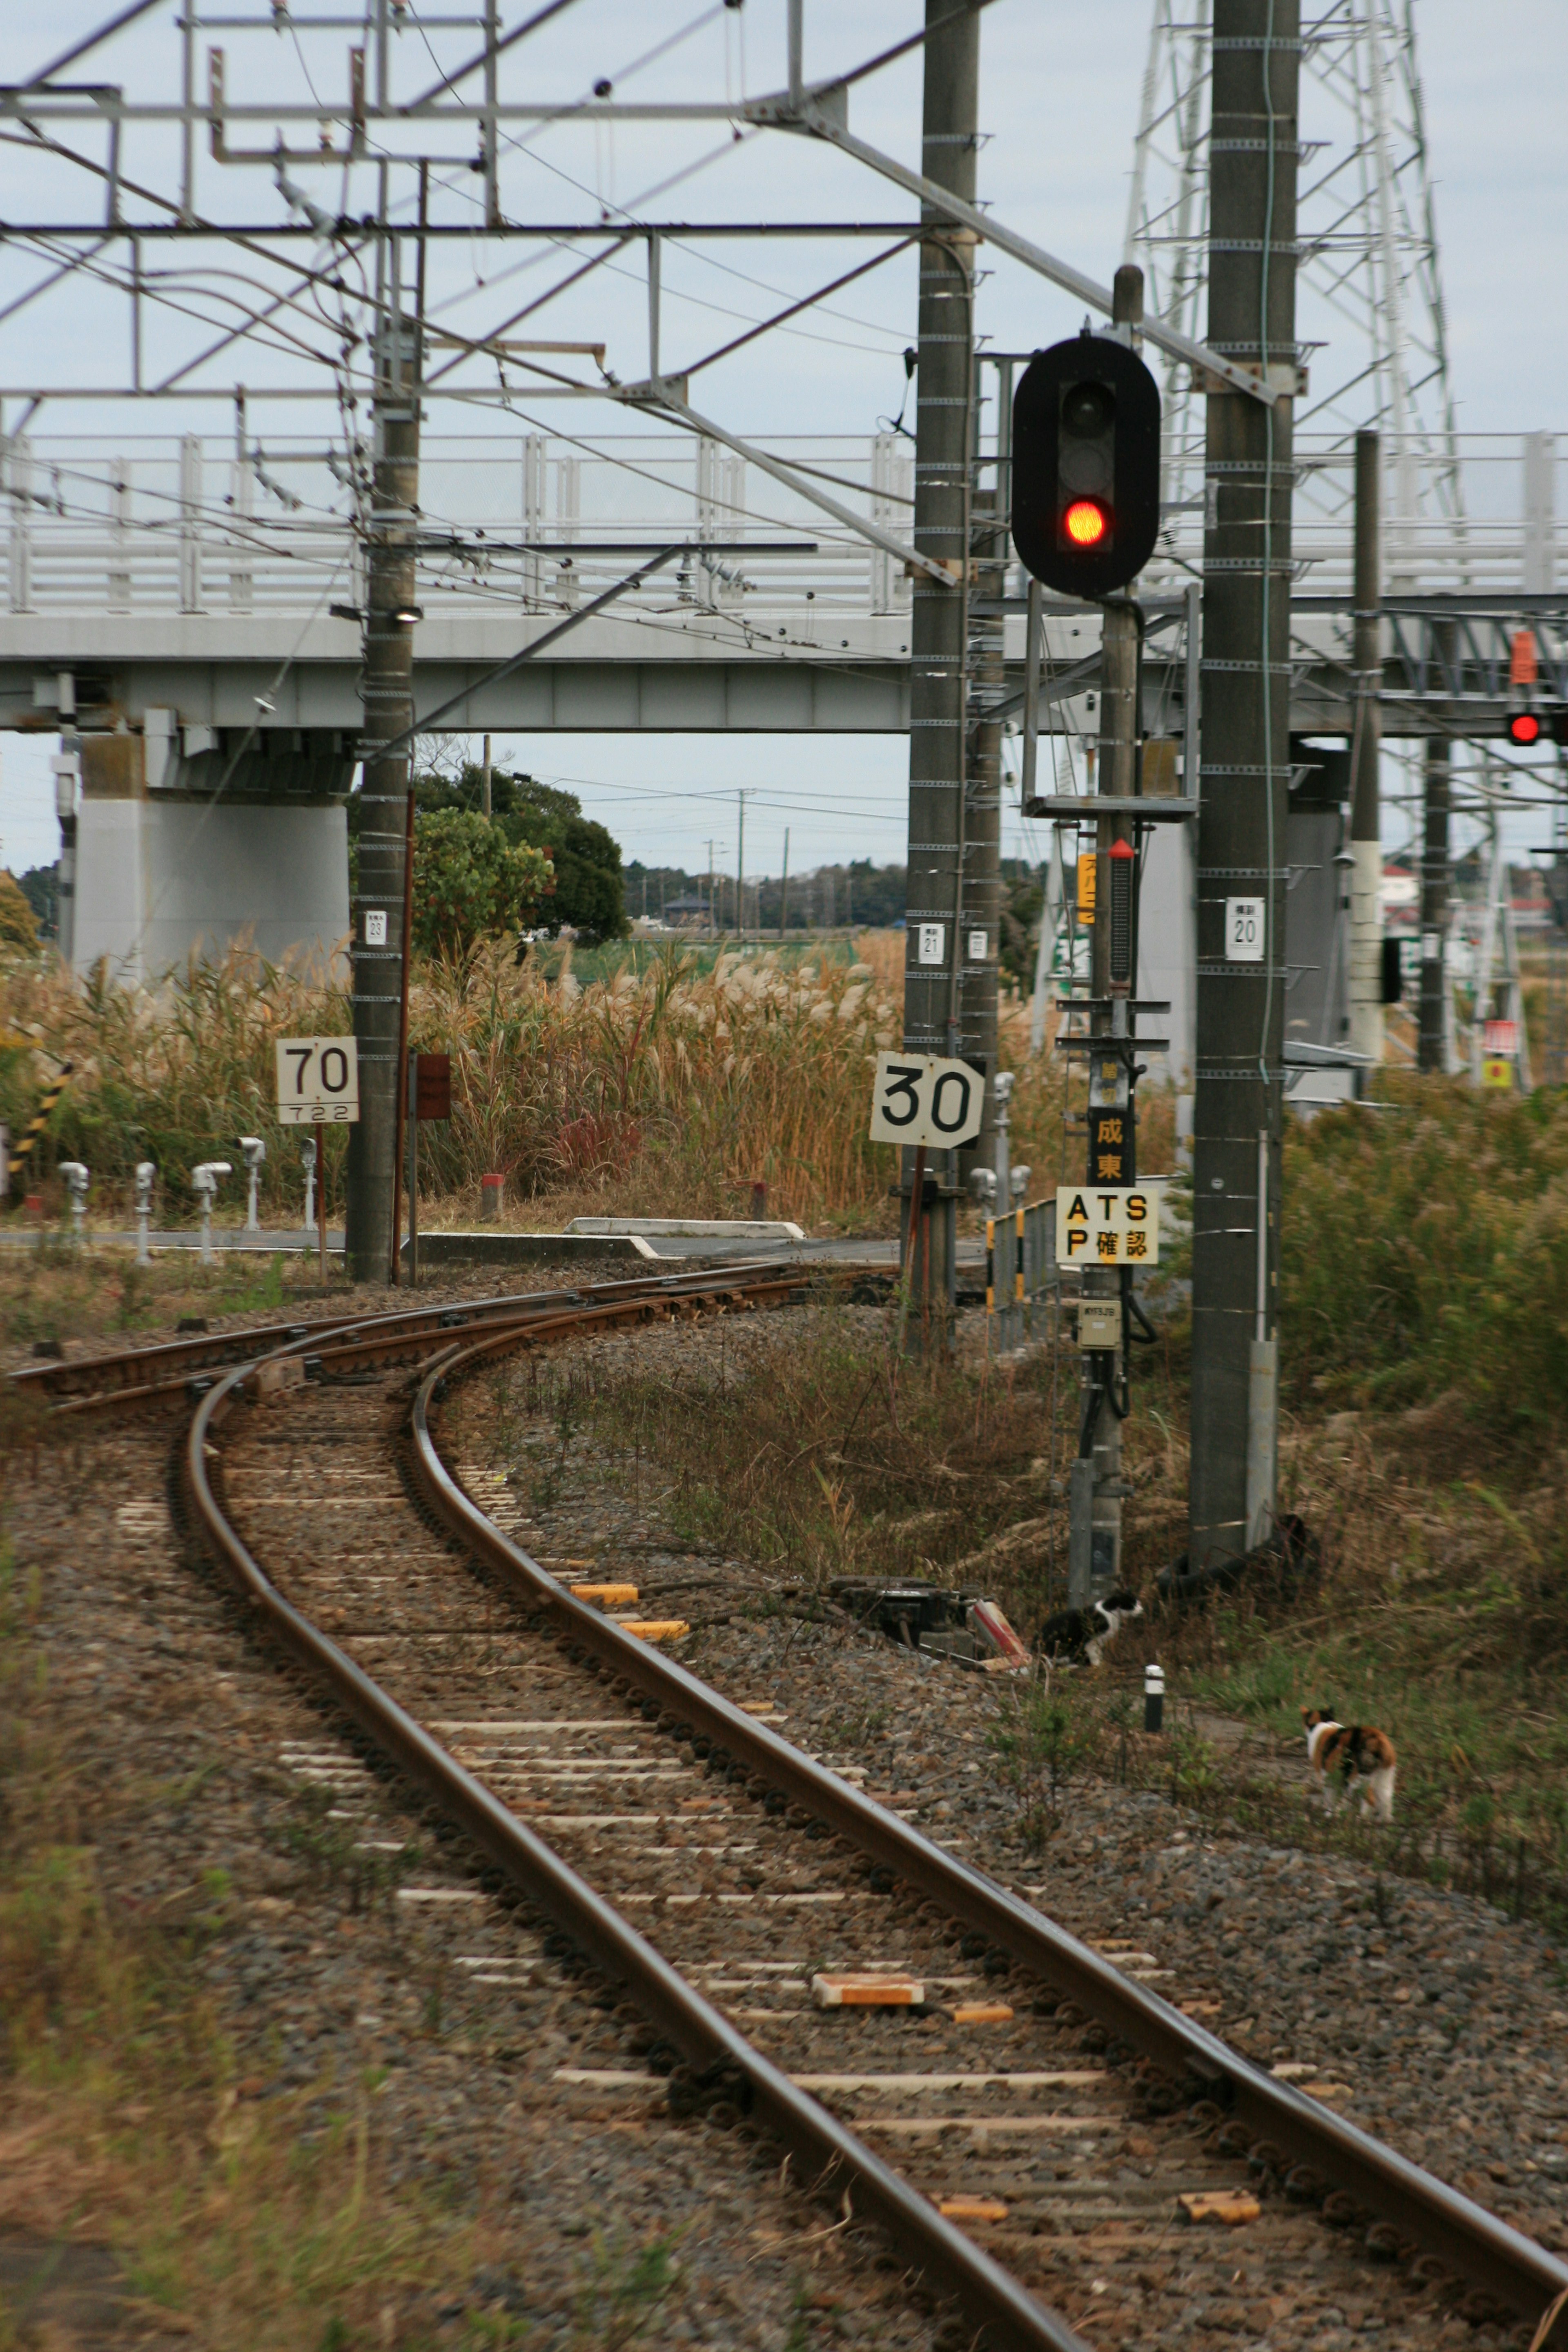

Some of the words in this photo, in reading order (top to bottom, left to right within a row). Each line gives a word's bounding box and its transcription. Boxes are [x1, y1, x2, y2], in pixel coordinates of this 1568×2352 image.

[924, 938, 937, 953] 21
[1235, 920, 1256, 942] 20
[286, 1047, 348, 1094] 70
[882, 1065, 971, 1132] 30
[1097, 1118, 1123, 1179] 成東
[1067, 1194, 1147, 1221] ATS
